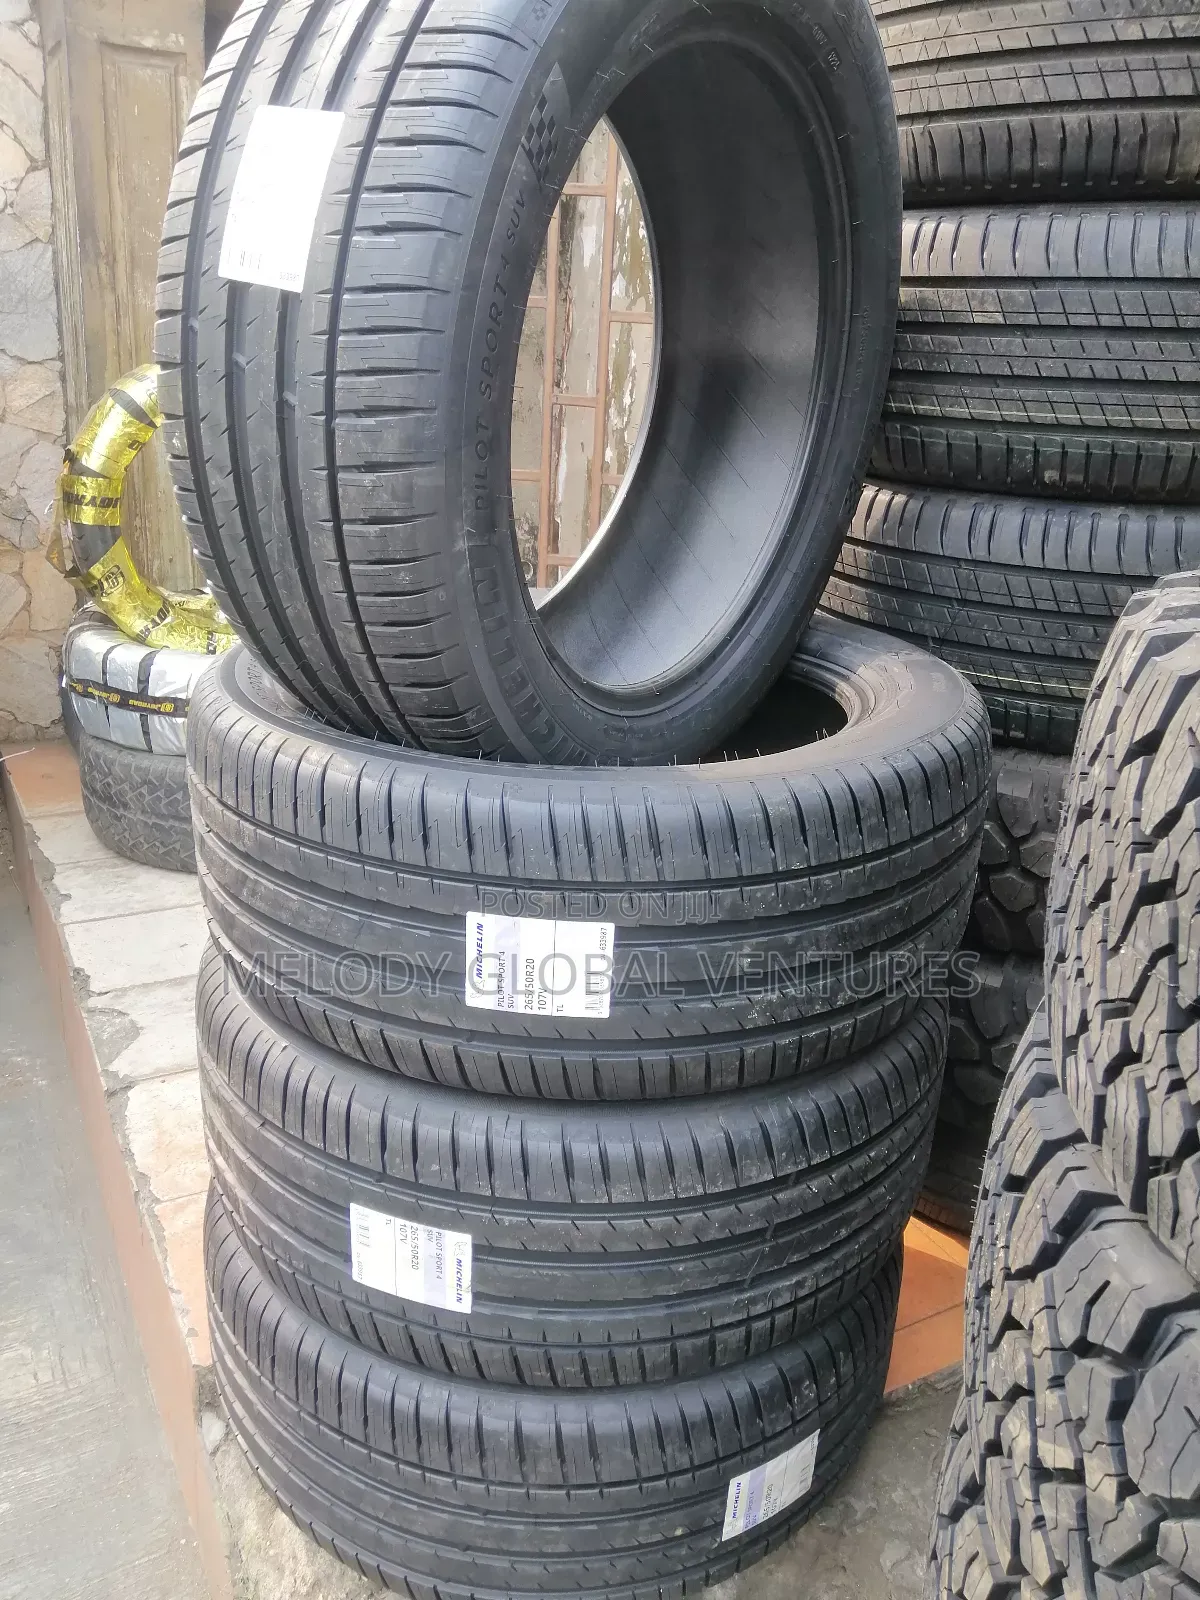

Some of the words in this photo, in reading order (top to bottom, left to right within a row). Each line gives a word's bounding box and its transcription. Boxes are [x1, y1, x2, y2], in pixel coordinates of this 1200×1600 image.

[506, 189, 527, 246] SUV
[479, 276, 509, 400] SPORT
[475, 417, 490, 511] PILOT
[475, 922, 484, 979] MICHELIN
[498, 958, 506, 983] SPORT
[524, 958, 535, 1011] 265/50R20
[507, 994, 515, 1009] SUV
[538, 987, 547, 1011] 107V
[399, 1223, 408, 1245] 107V
[410, 1225, 419, 1271] 265/50R20
[426, 1229, 434, 1243] SUV
[435, 1231, 443, 1252] PILOT
[435, 1252, 443, 1275] SPORT
[732, 1482, 742, 1519] MICHELIN
